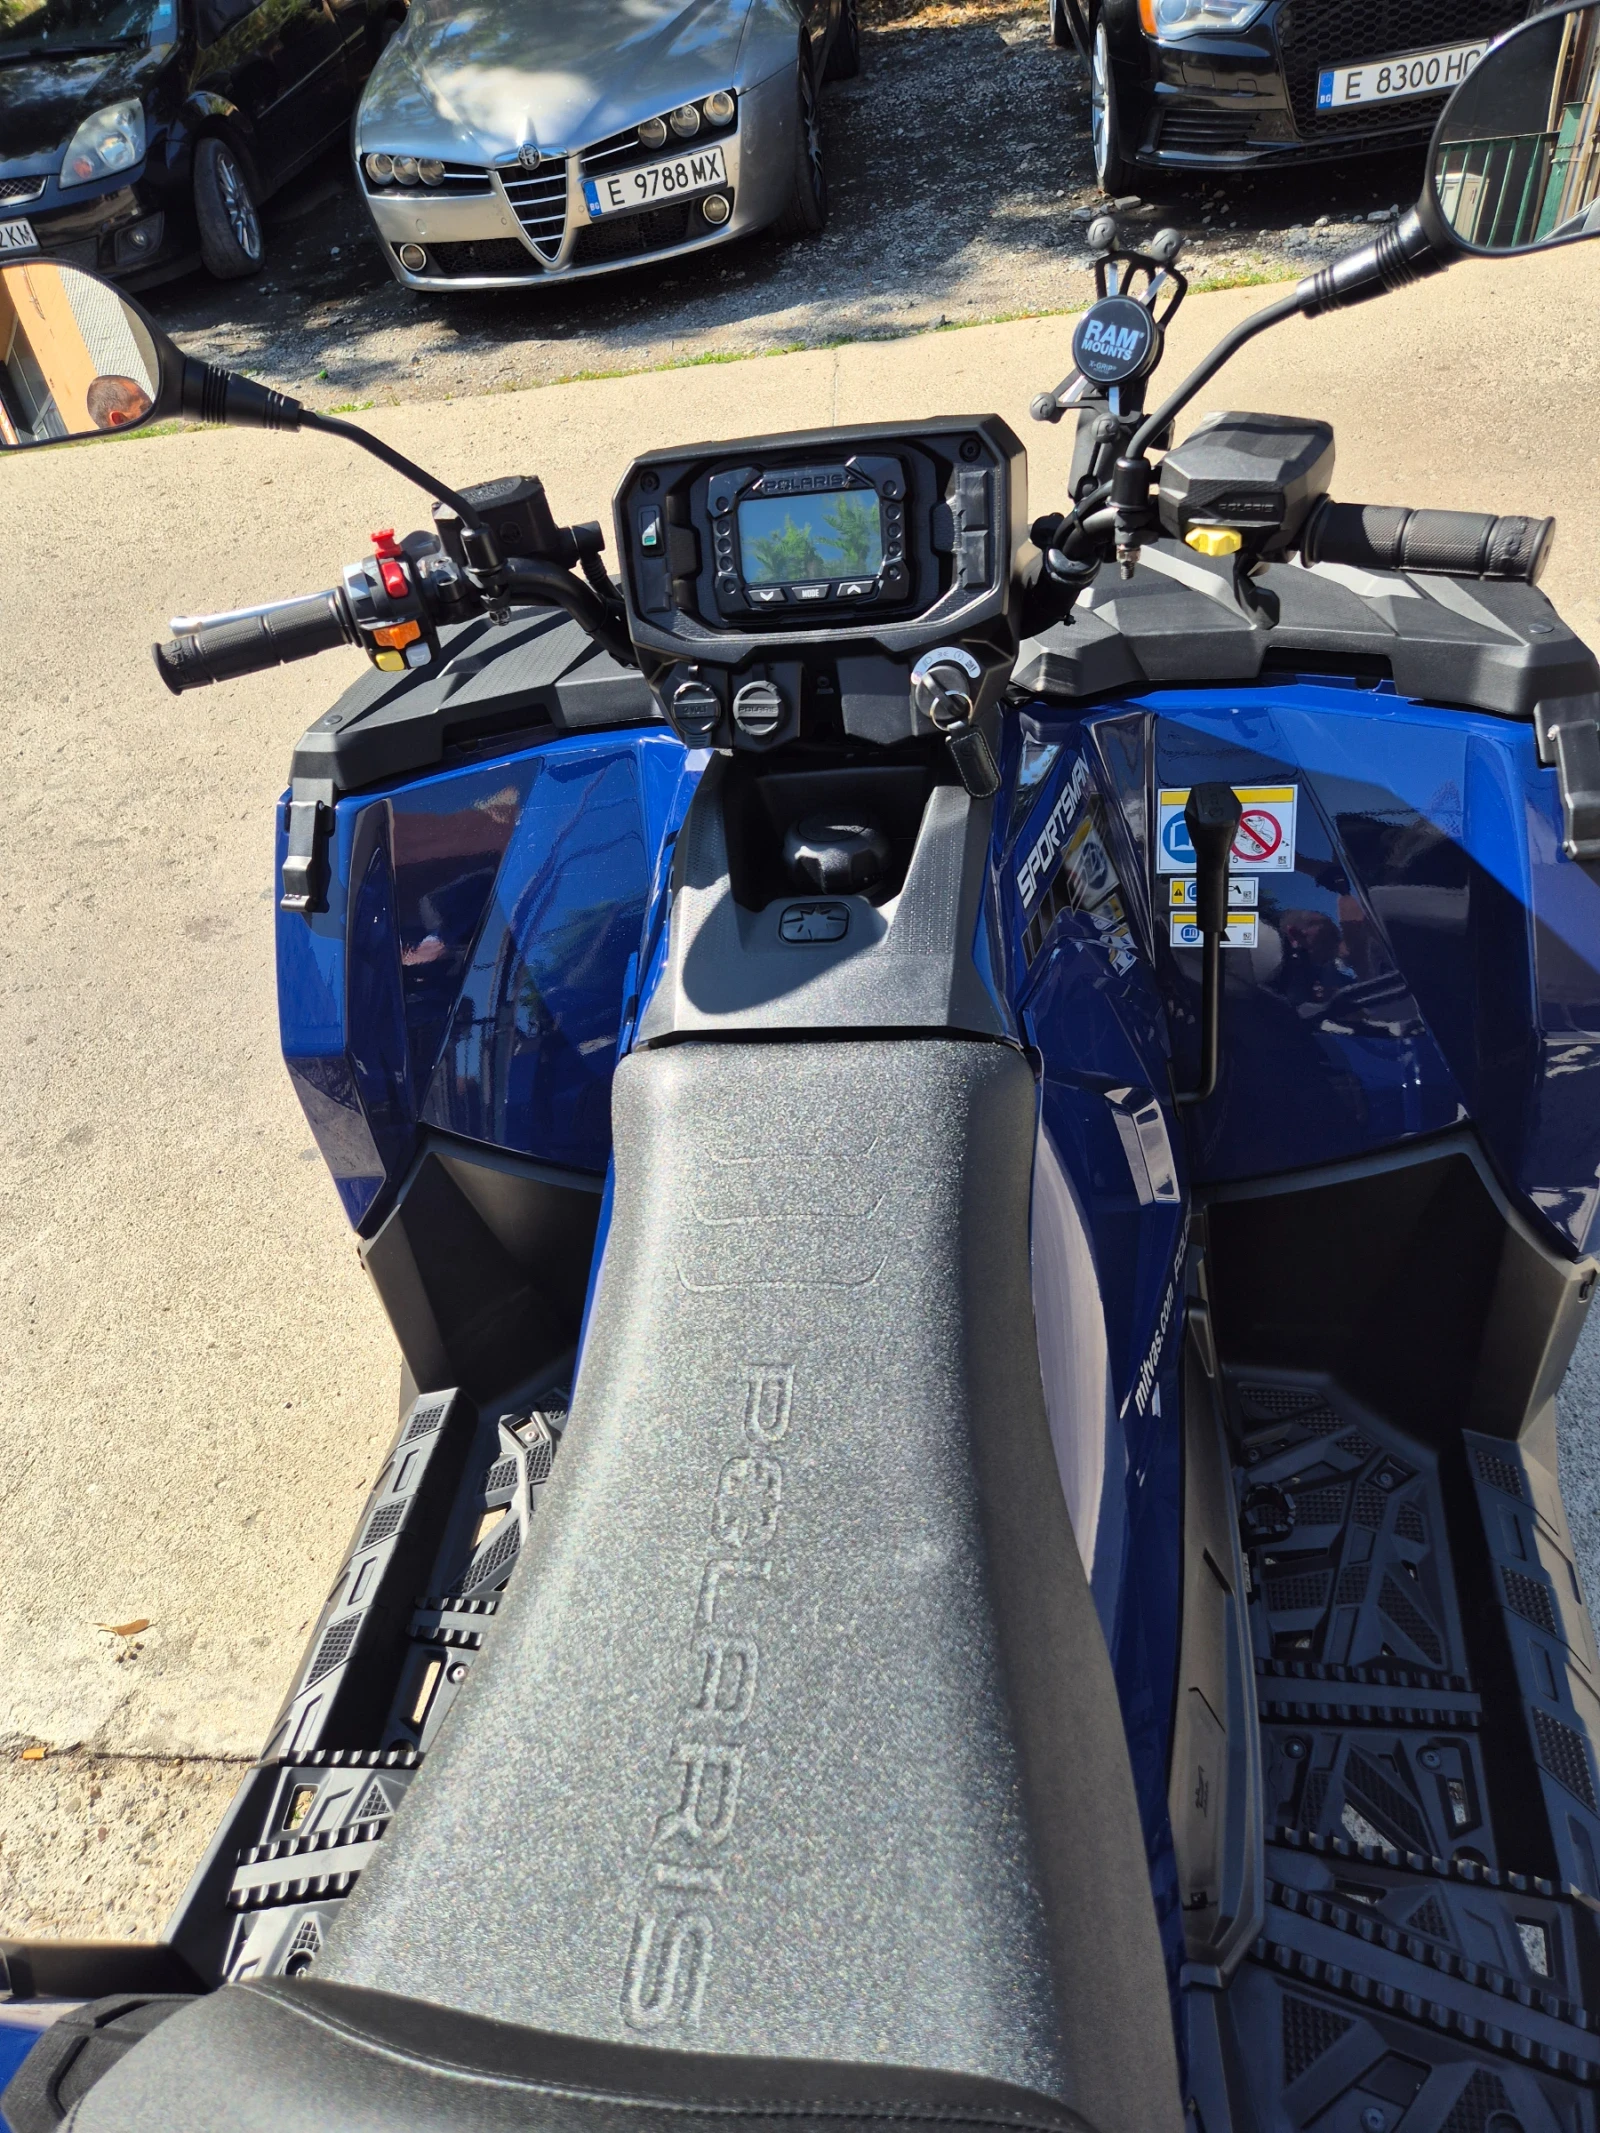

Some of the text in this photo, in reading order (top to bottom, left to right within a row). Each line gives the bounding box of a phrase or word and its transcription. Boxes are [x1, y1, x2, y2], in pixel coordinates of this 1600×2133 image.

[1345, 71, 1363, 101] E
[607, 179, 625, 206] E
[1081, 338, 1133, 361] MOUNTS
[764, 473, 844, 493] POLARIS
[801, 588, 820, 599] MODE
[1016, 747, 1090, 909] SPORTSMAN
[1134, 1281, 1174, 1418] mitvas.com
[620, 1363, 797, 2031] POLARIS
